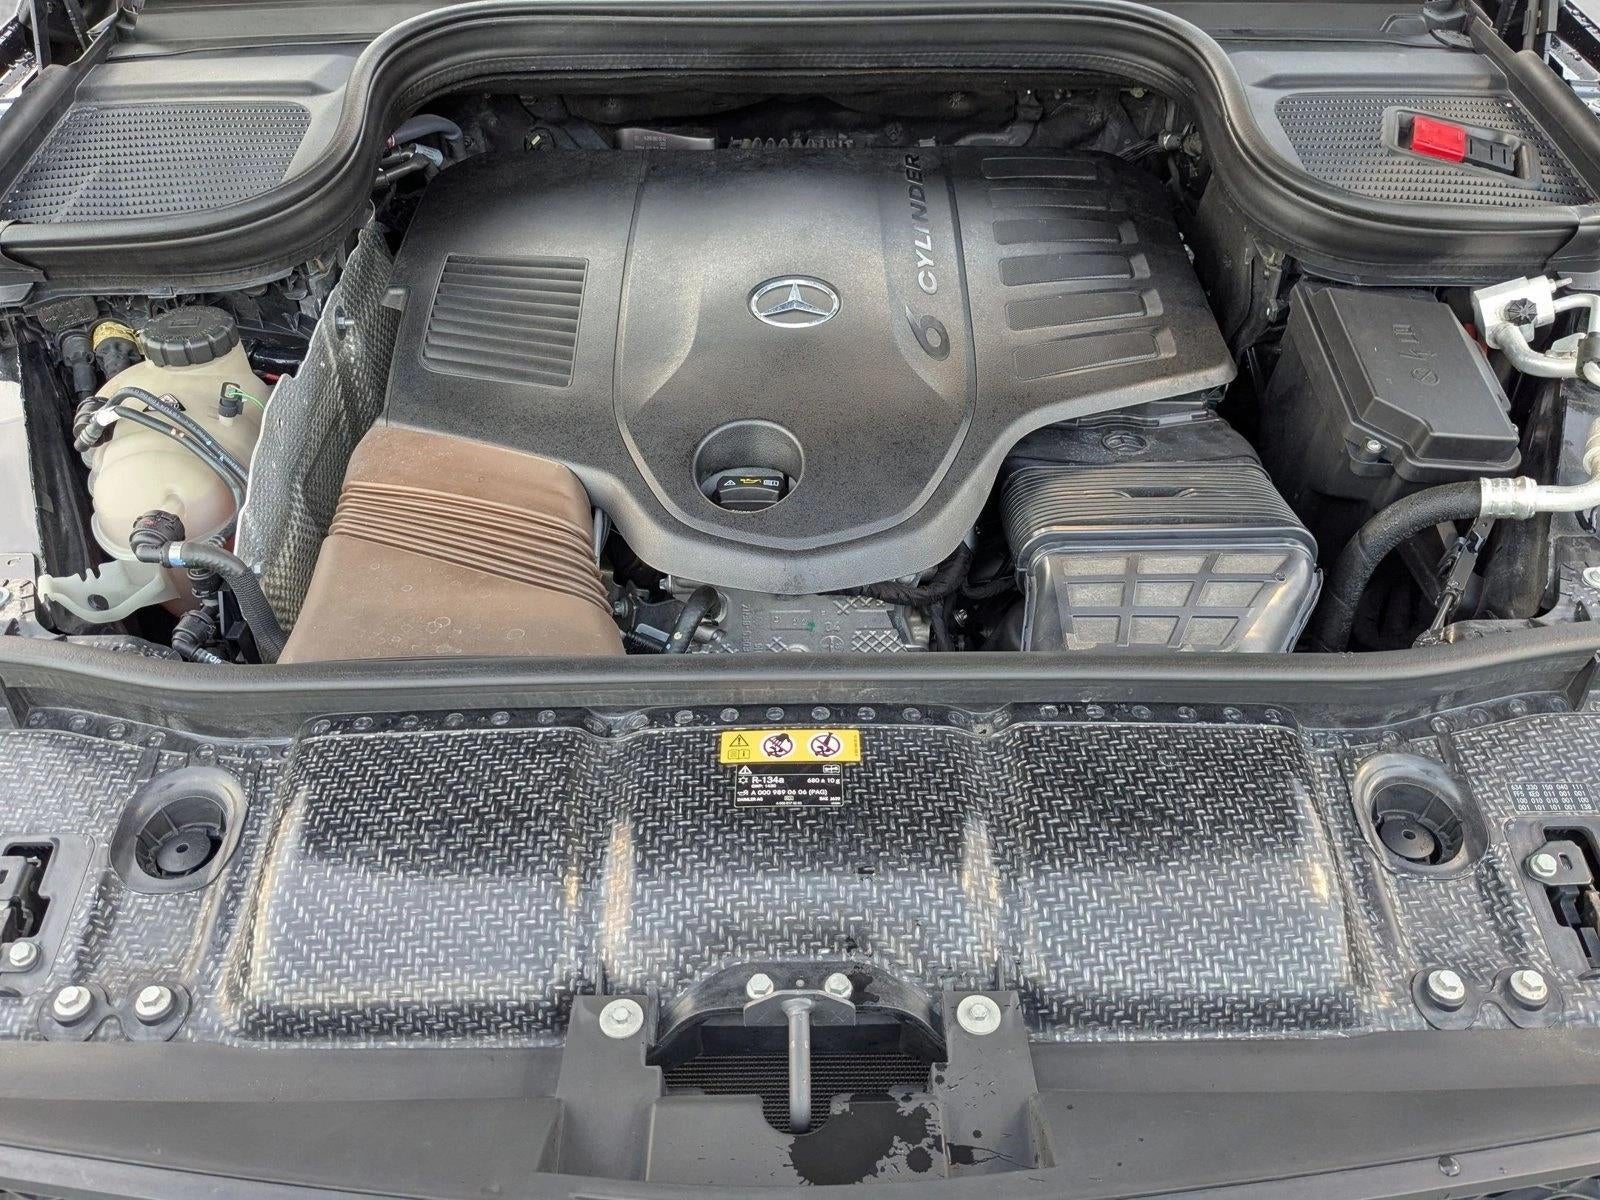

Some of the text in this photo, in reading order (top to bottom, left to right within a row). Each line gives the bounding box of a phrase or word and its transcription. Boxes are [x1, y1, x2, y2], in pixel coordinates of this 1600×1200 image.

[904, 153, 950, 361] 6 CYLINDER
[751, 776, 785, 784] R-134a
